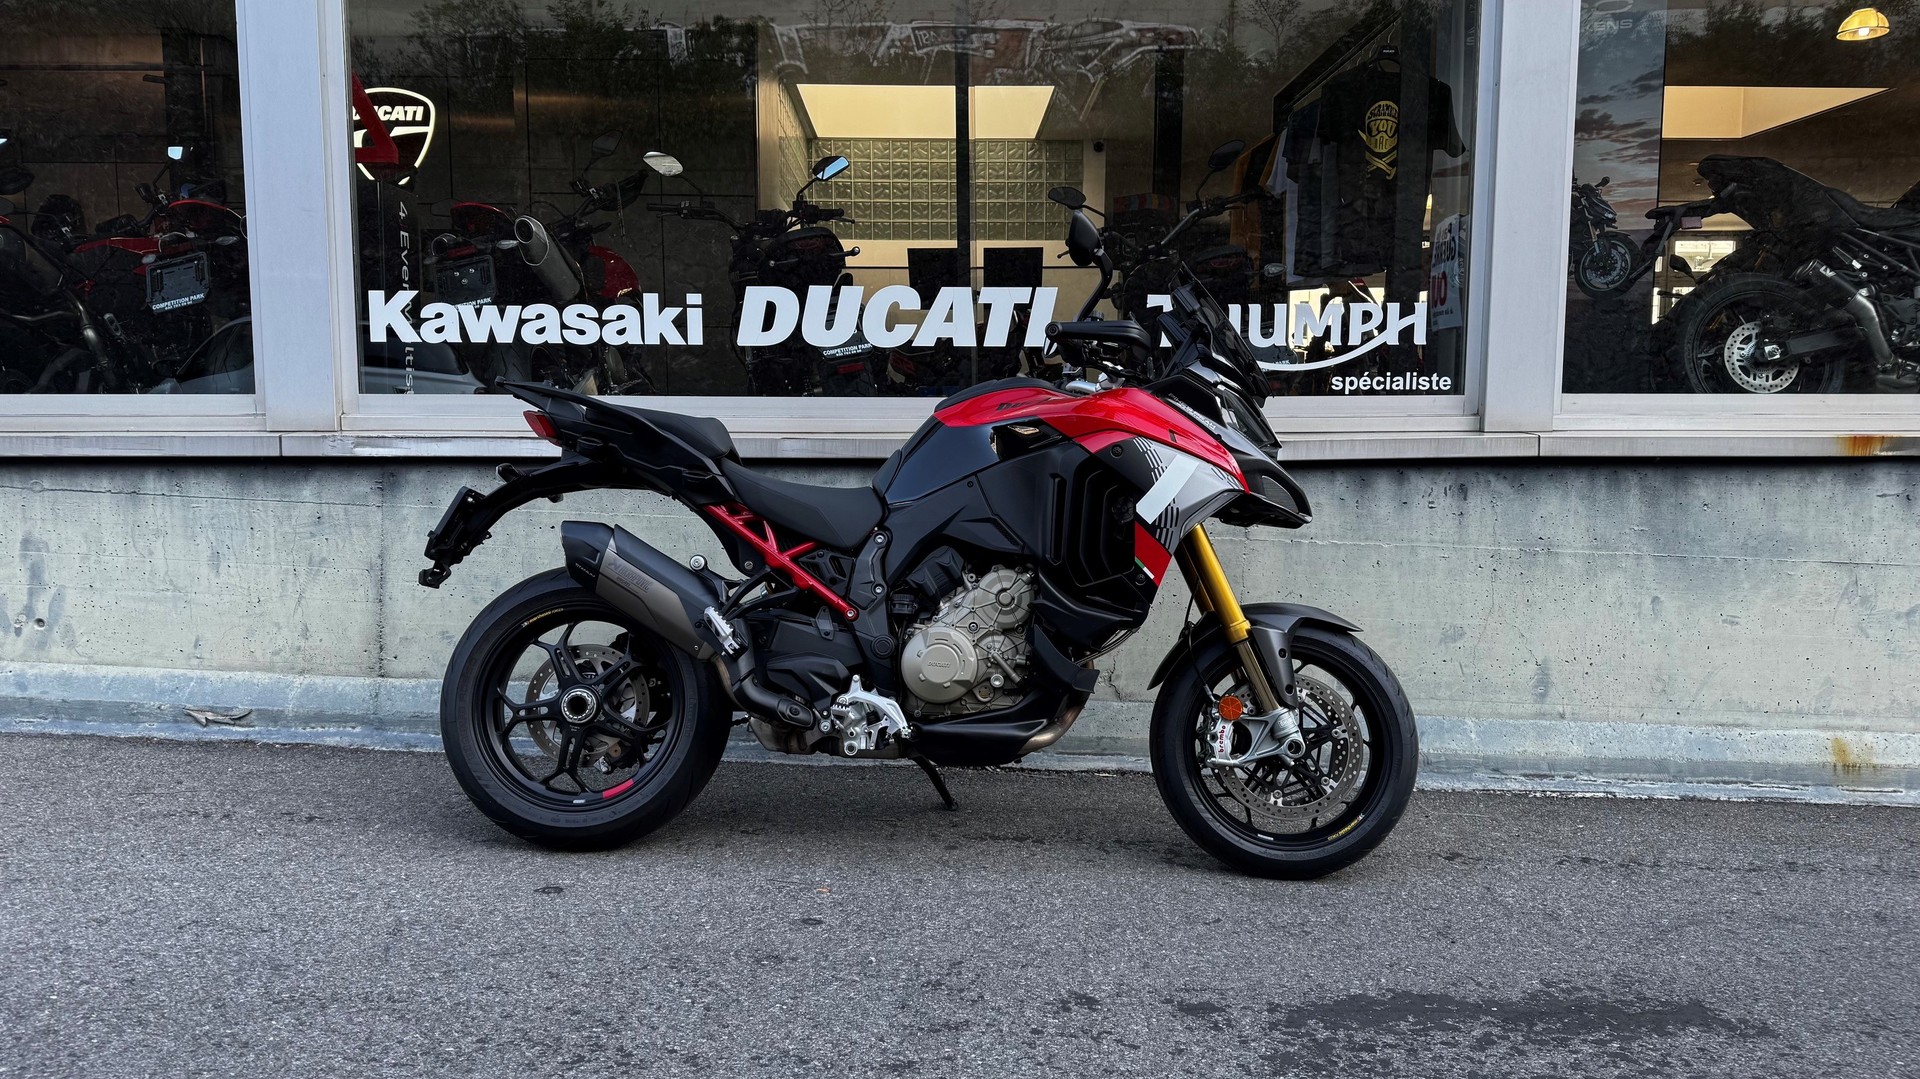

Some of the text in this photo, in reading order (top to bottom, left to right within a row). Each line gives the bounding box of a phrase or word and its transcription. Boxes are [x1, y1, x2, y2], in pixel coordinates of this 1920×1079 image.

[352, 105, 424, 121] CATI
[1369, 120, 1397, 136] YOU
[152, 296, 189, 310] COMPETITION
[190, 293, 205, 301] PARK
[368, 290, 703, 346] Kawasaki
[736, 285, 1059, 348] DUCATI
[823, 345, 858, 356] COMPETITION
[1331, 372, 1452, 395] spécialiste
[1218, 725, 1226, 753] brembo
